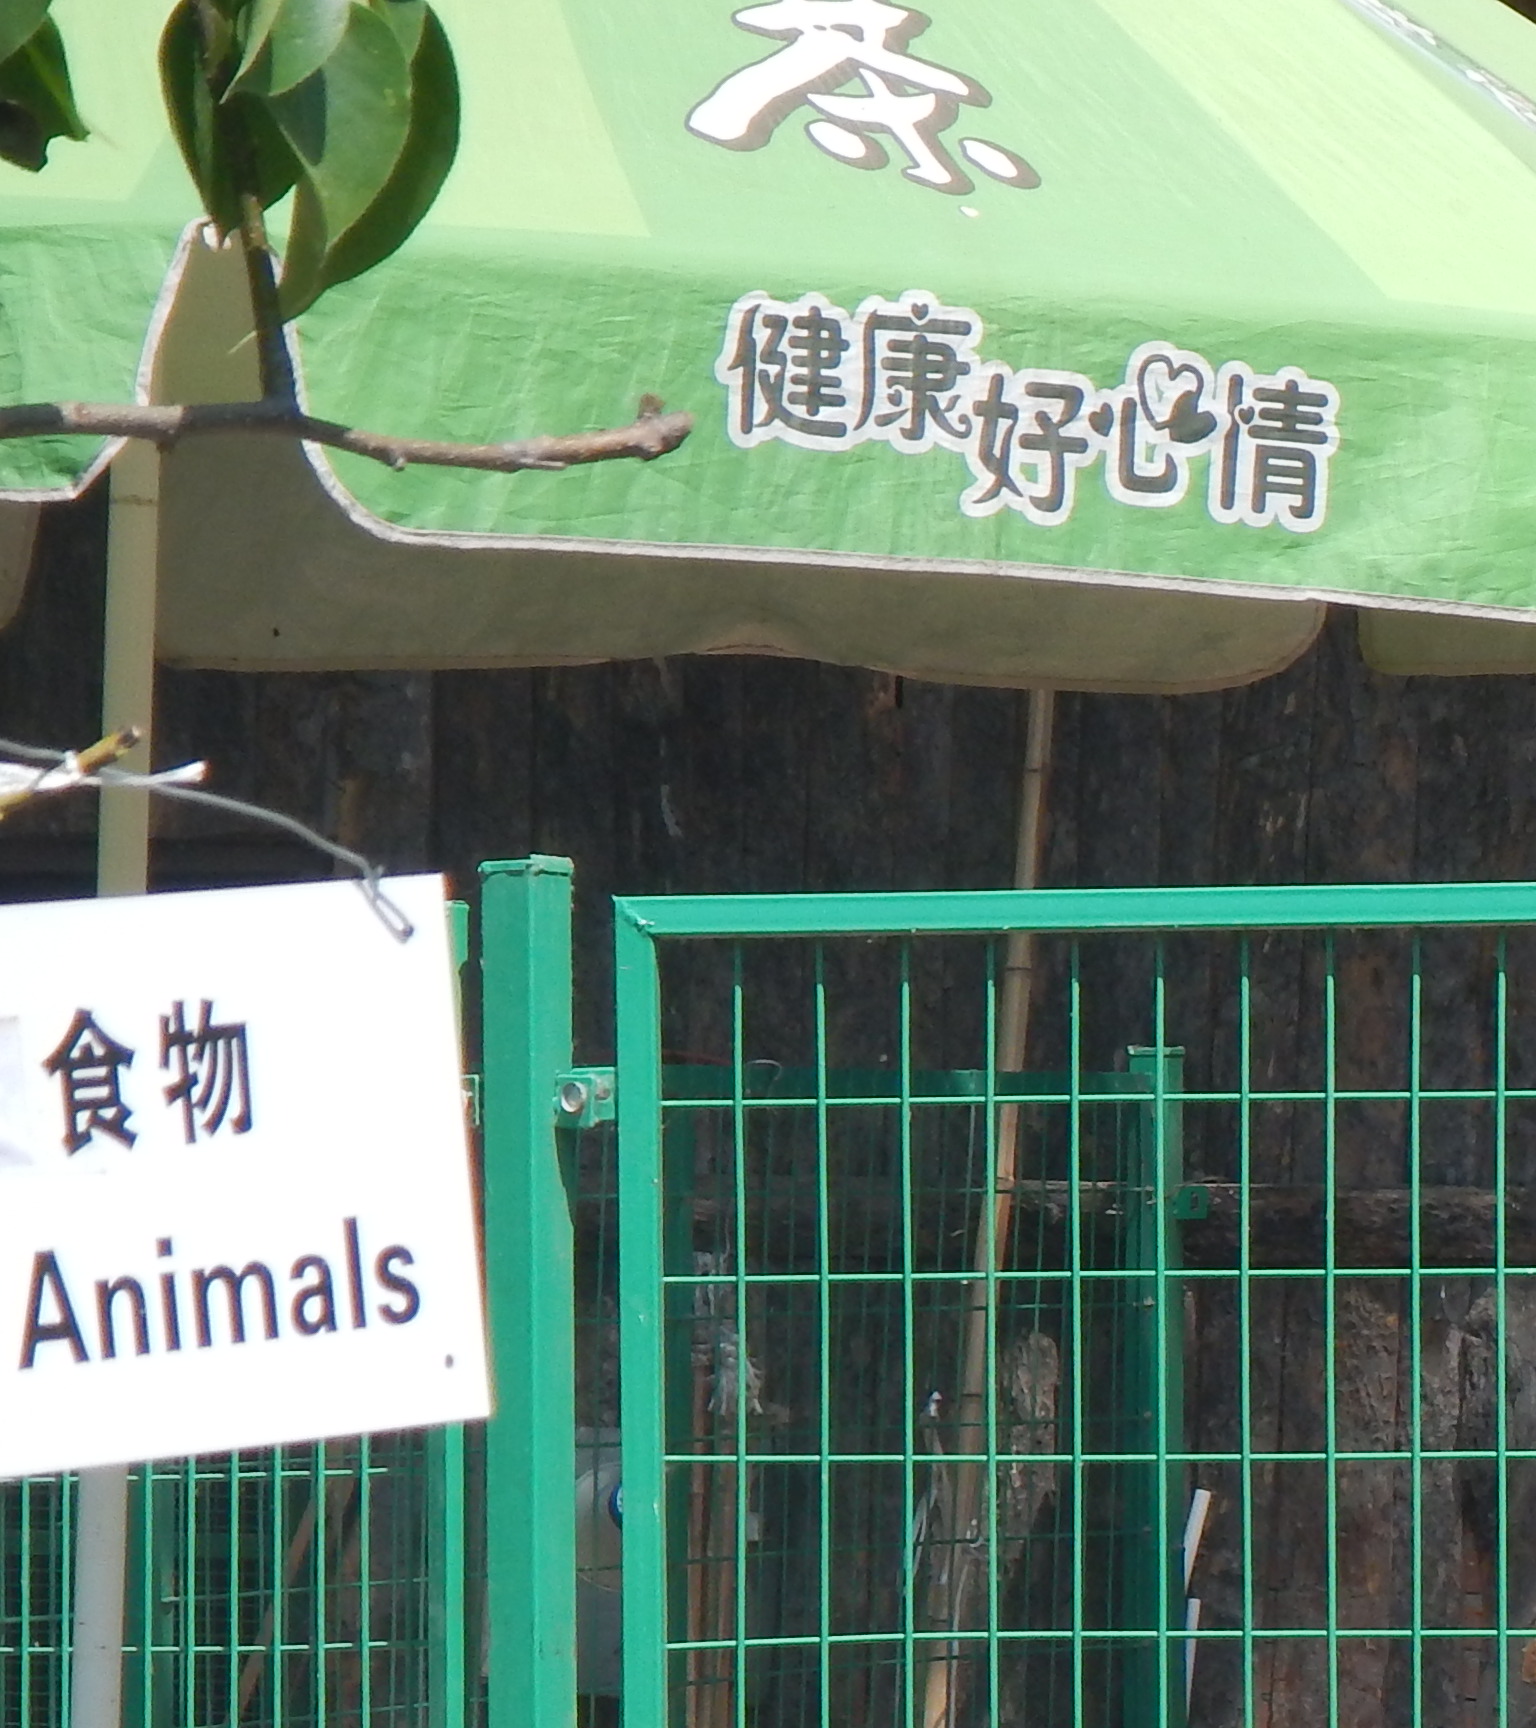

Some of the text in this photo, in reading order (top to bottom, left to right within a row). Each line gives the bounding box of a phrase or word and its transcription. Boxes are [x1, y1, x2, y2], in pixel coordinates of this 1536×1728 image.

[720, 294, 1336, 528] 健康好心情
[40, 998, 254, 1157] 食物
[17, 1215, 421, 1371] Animals
